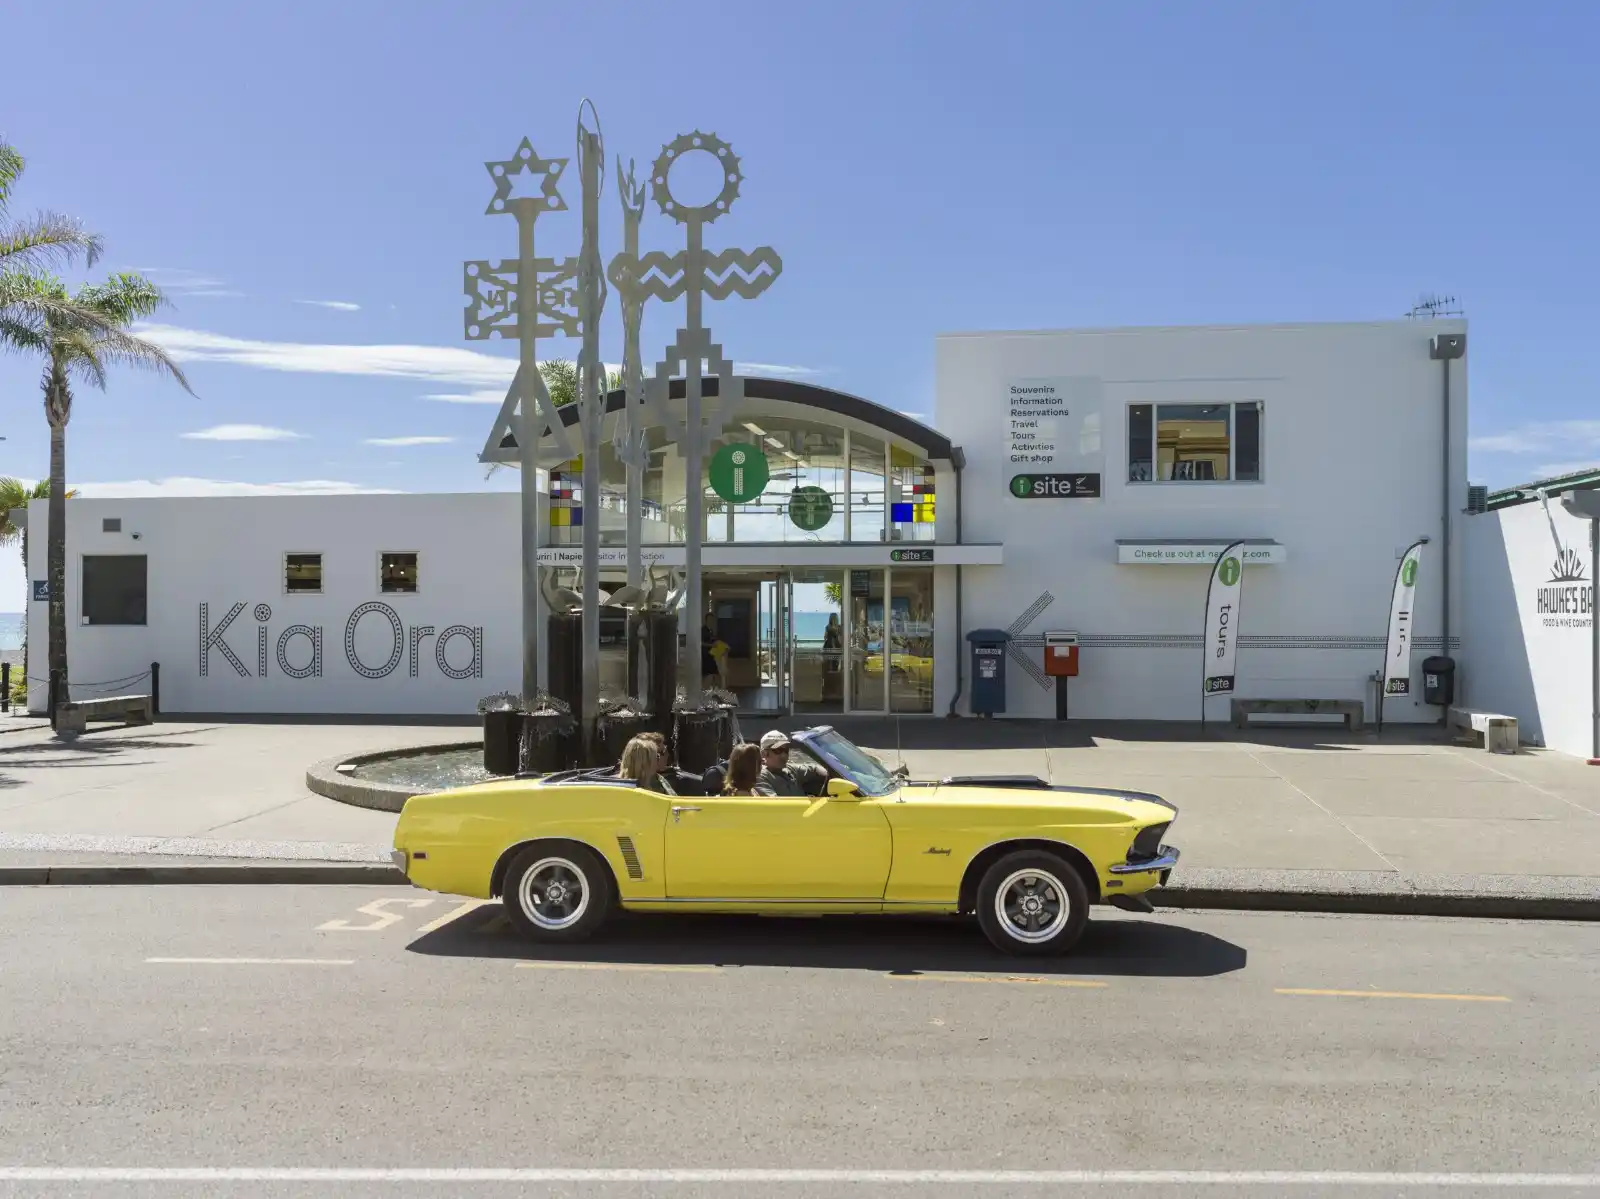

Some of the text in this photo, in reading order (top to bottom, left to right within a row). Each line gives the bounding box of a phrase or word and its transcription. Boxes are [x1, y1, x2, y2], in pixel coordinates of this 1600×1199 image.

[1010, 386, 1055, 394] Souvenirs
[1010, 397, 1063, 405] Information
[1010, 408, 1069, 417] Reservations
[1011, 420, 1038, 428] Travel
[1011, 431, 1036, 440] Tours
[1011, 442, 1055, 451] Activities
[1010, 454, 1053, 464] Gift shop
[1033, 476, 1071, 494] site
[559, 552, 582, 561] Napie
[901, 550, 920, 560] site
[1134, 549, 1165, 558] Check
[1165, 550, 1175, 558] us
[1178, 550, 1194, 558] out
[1195, 550, 1205, 558] at
[1537, 586, 1593, 614] HAWKE'S BA
[1573, 618, 1592, 628] COUNTR
[1216, 603, 1232, 659] tours
[199, 601, 483, 679] Kia Ora
[1212, 677, 1230, 690] site
[1392, 679, 1405, 691] site
